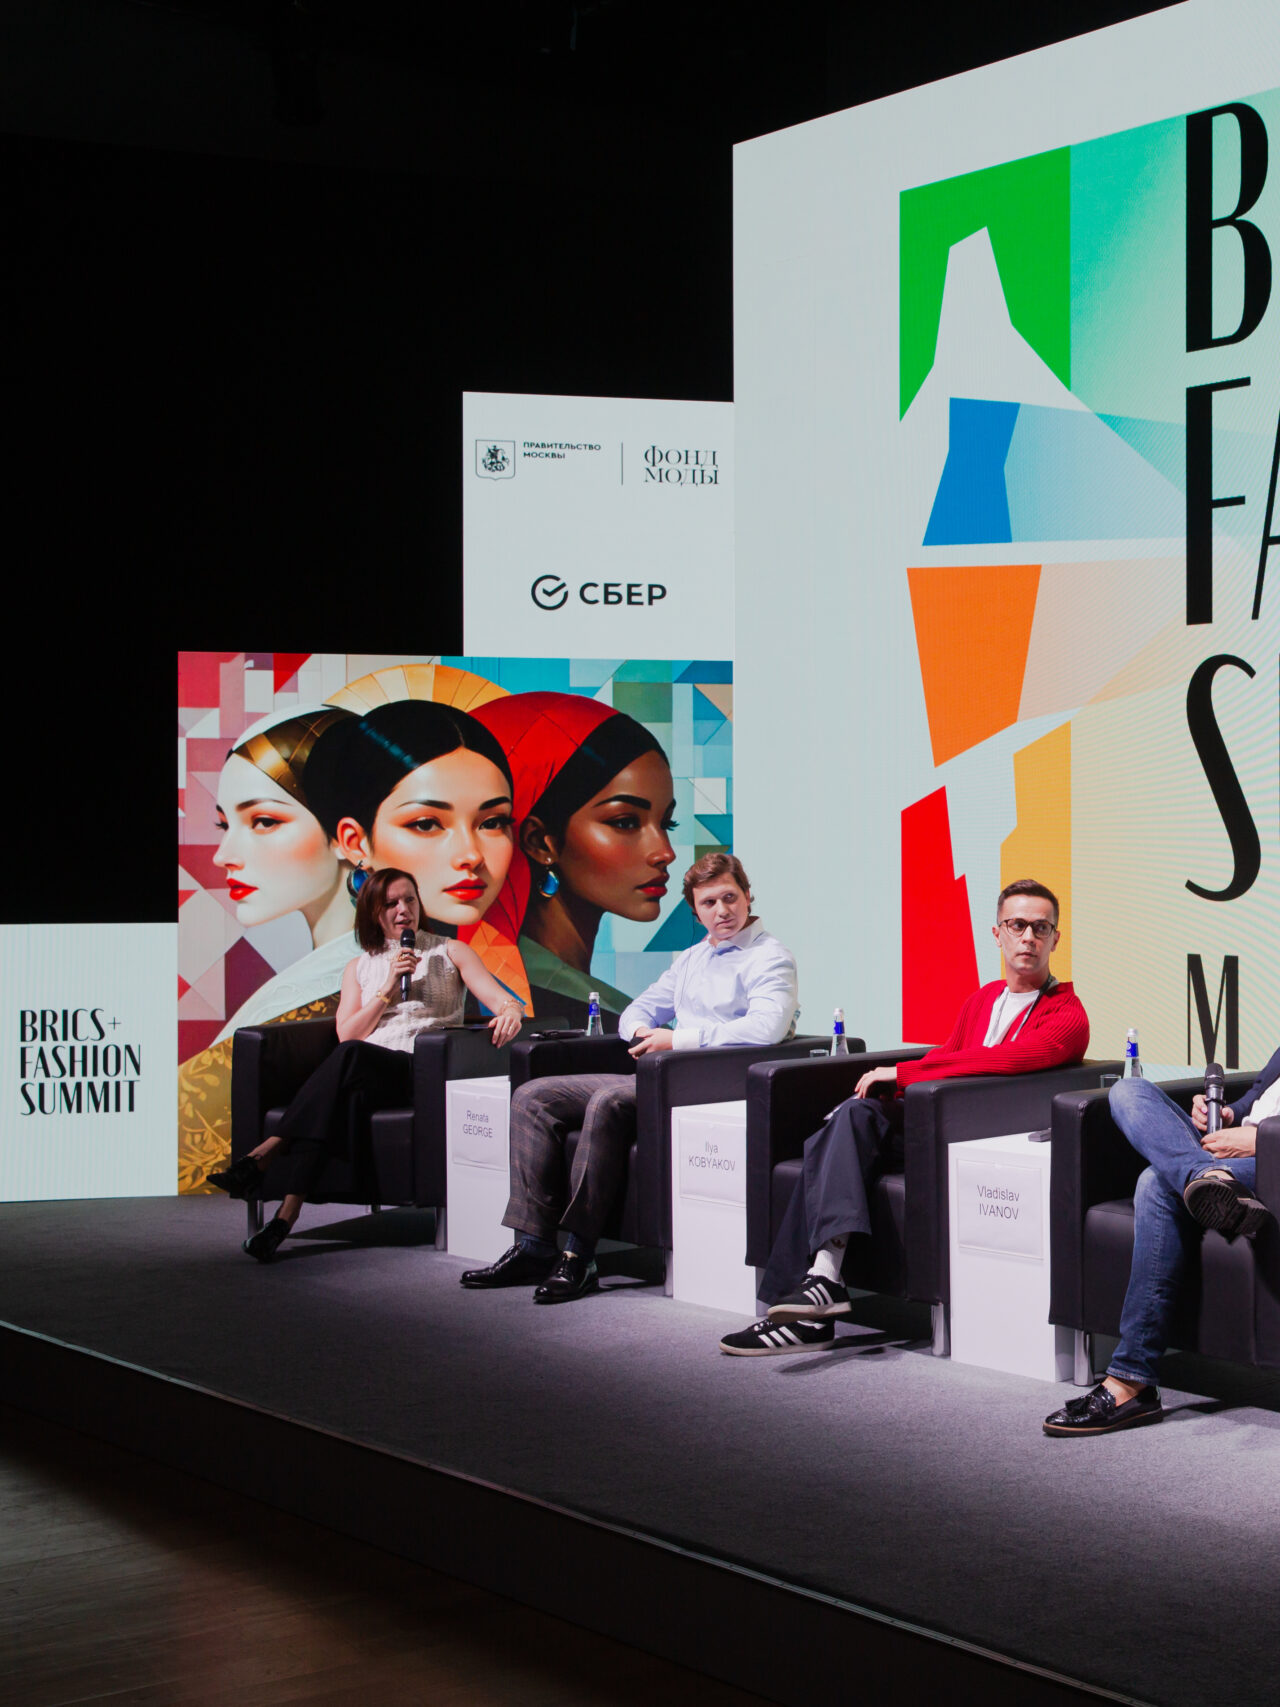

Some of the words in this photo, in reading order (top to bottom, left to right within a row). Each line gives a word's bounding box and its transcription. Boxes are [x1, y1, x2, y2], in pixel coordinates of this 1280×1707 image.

[523, 442, 601, 451] ПРАВИТЕЛЬСТВО
[644, 445, 718, 467] ФОНД
[644, 467, 719, 486] МОДЫ
[579, 582, 667, 606] СБЕР
[20, 1008, 121, 1042] BRICS+
[20, 1044, 141, 1079] FASHION
[20, 1080, 141, 1116] SUMMIT
[466, 1109, 489, 1123] Renata
[463, 1123, 494, 1138] GEORGE
[705, 1140, 719, 1156] Ilya
[688, 1155, 736, 1171] KOBYAKOV
[977, 1184, 1020, 1202] Vladislav
[979, 1203, 1019, 1220] IVANOV
